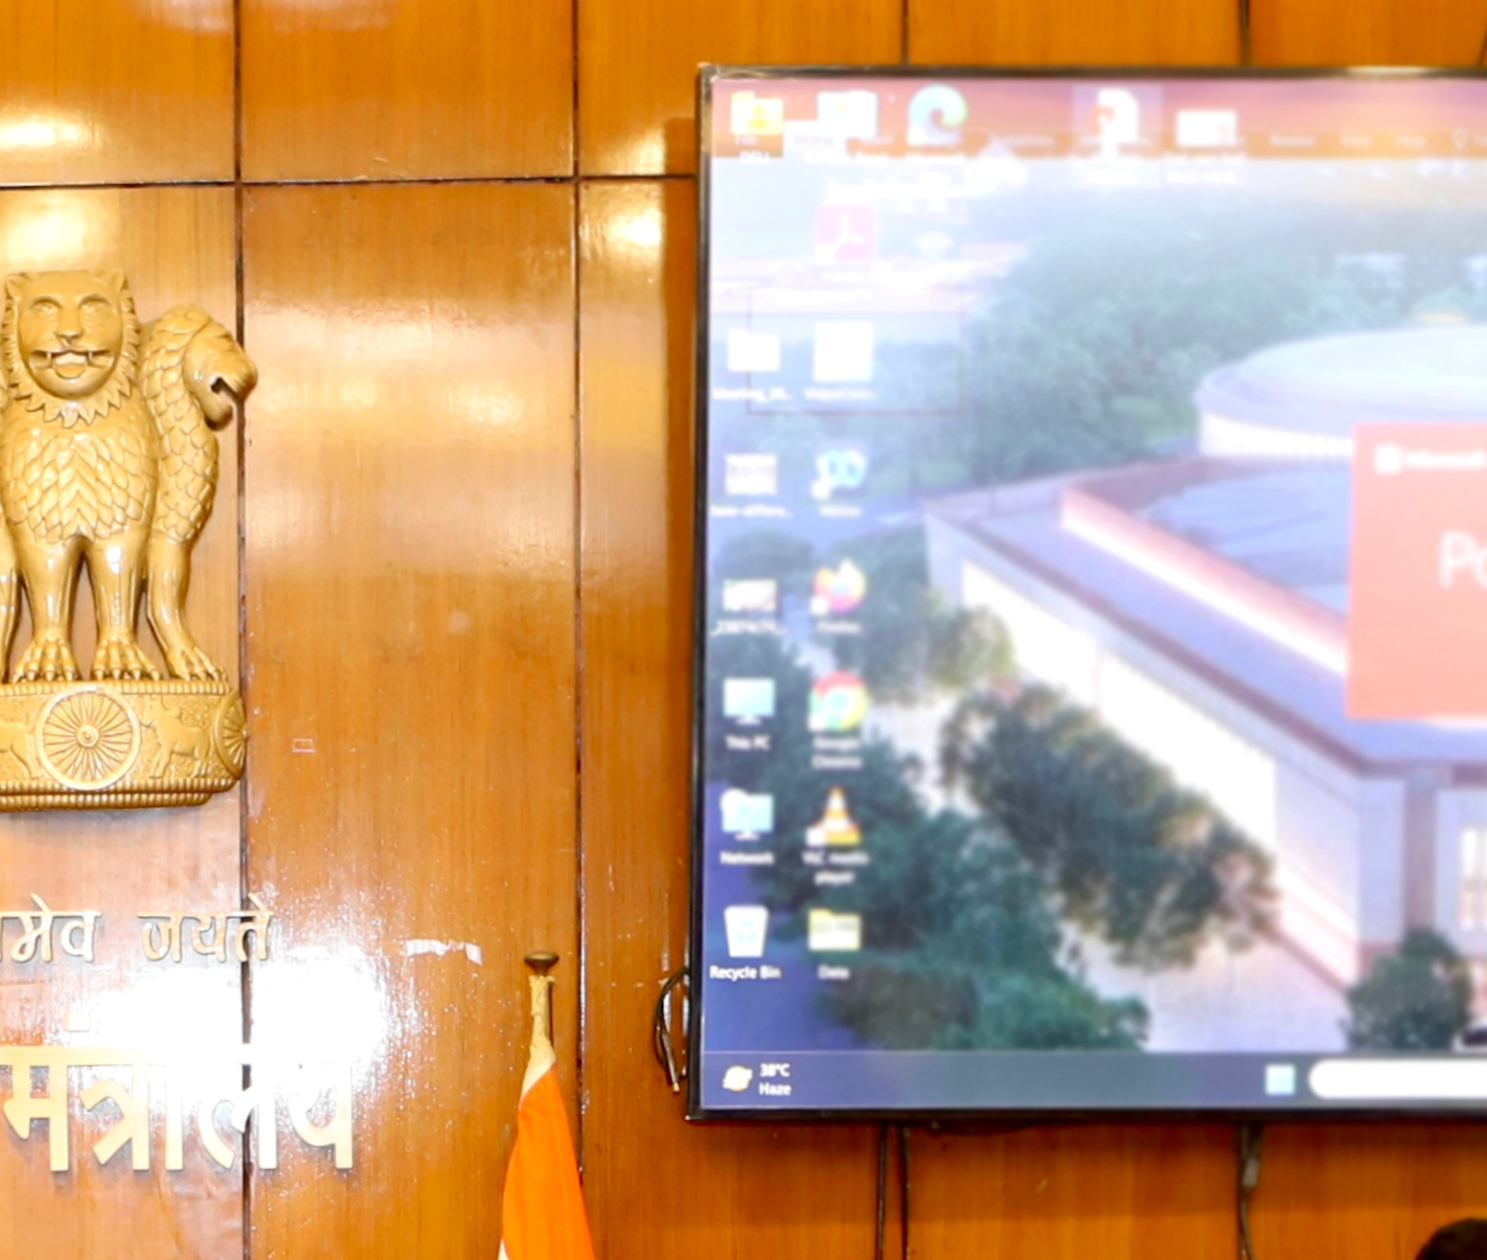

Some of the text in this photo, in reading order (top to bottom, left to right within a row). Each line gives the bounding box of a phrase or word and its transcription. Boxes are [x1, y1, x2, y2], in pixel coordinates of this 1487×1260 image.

[138, 893, 275, 963] जयते
[709, 965, 781, 981] Recycle Bin
[759, 1082, 792, 1097] Haze
